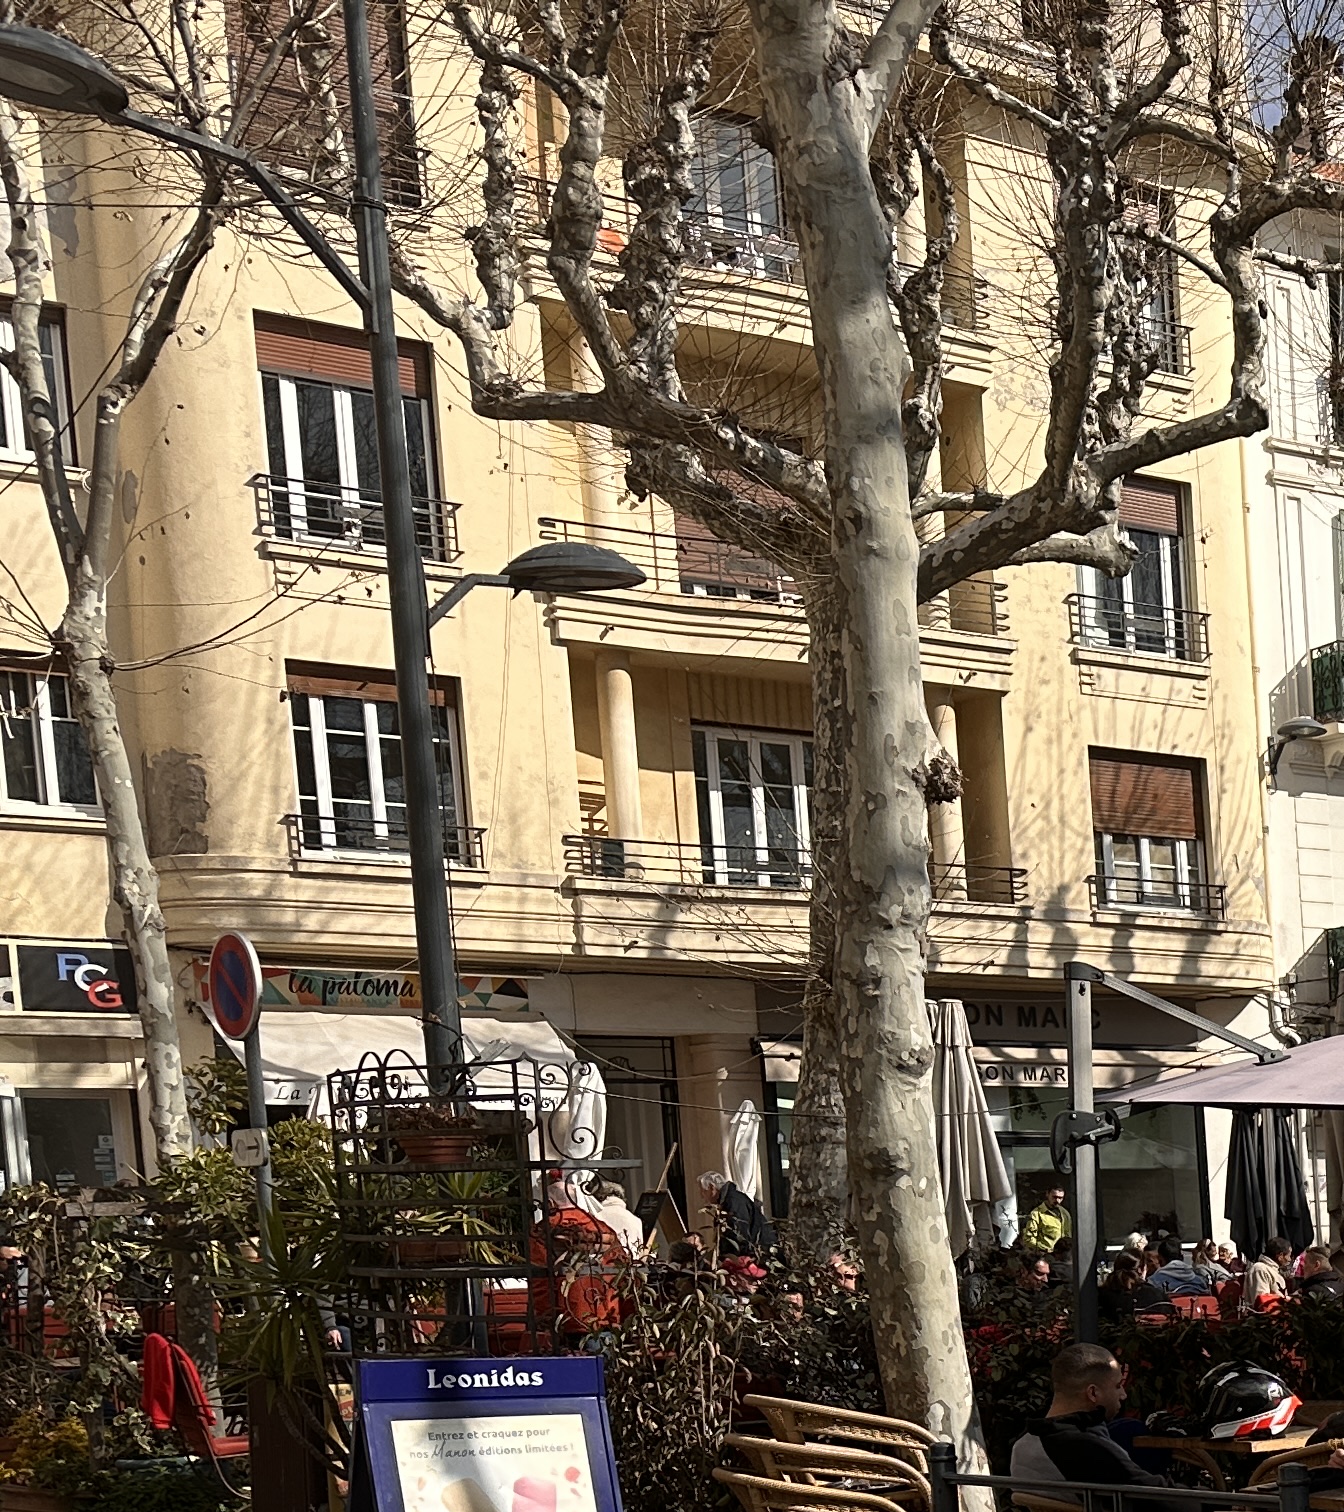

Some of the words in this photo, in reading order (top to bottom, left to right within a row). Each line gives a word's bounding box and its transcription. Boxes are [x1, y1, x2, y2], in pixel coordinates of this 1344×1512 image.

[321, 971, 417, 1005] paloma
[1023, 1066, 1067, 1081] MAR
[427, 1366, 544, 1389] Leonidas
[428, 1431, 464, 1441] Entrez
[466, 1430, 479, 1440] et
[481, 1429, 524, 1442] craquez
[526, 1428, 551, 1439] pour
[409, 1450, 429, 1459] nos
[431, 1439, 477, 1460] Manon
[478, 1445, 523, 1456] éditions
[525, 1443, 569, 1455] limitées
